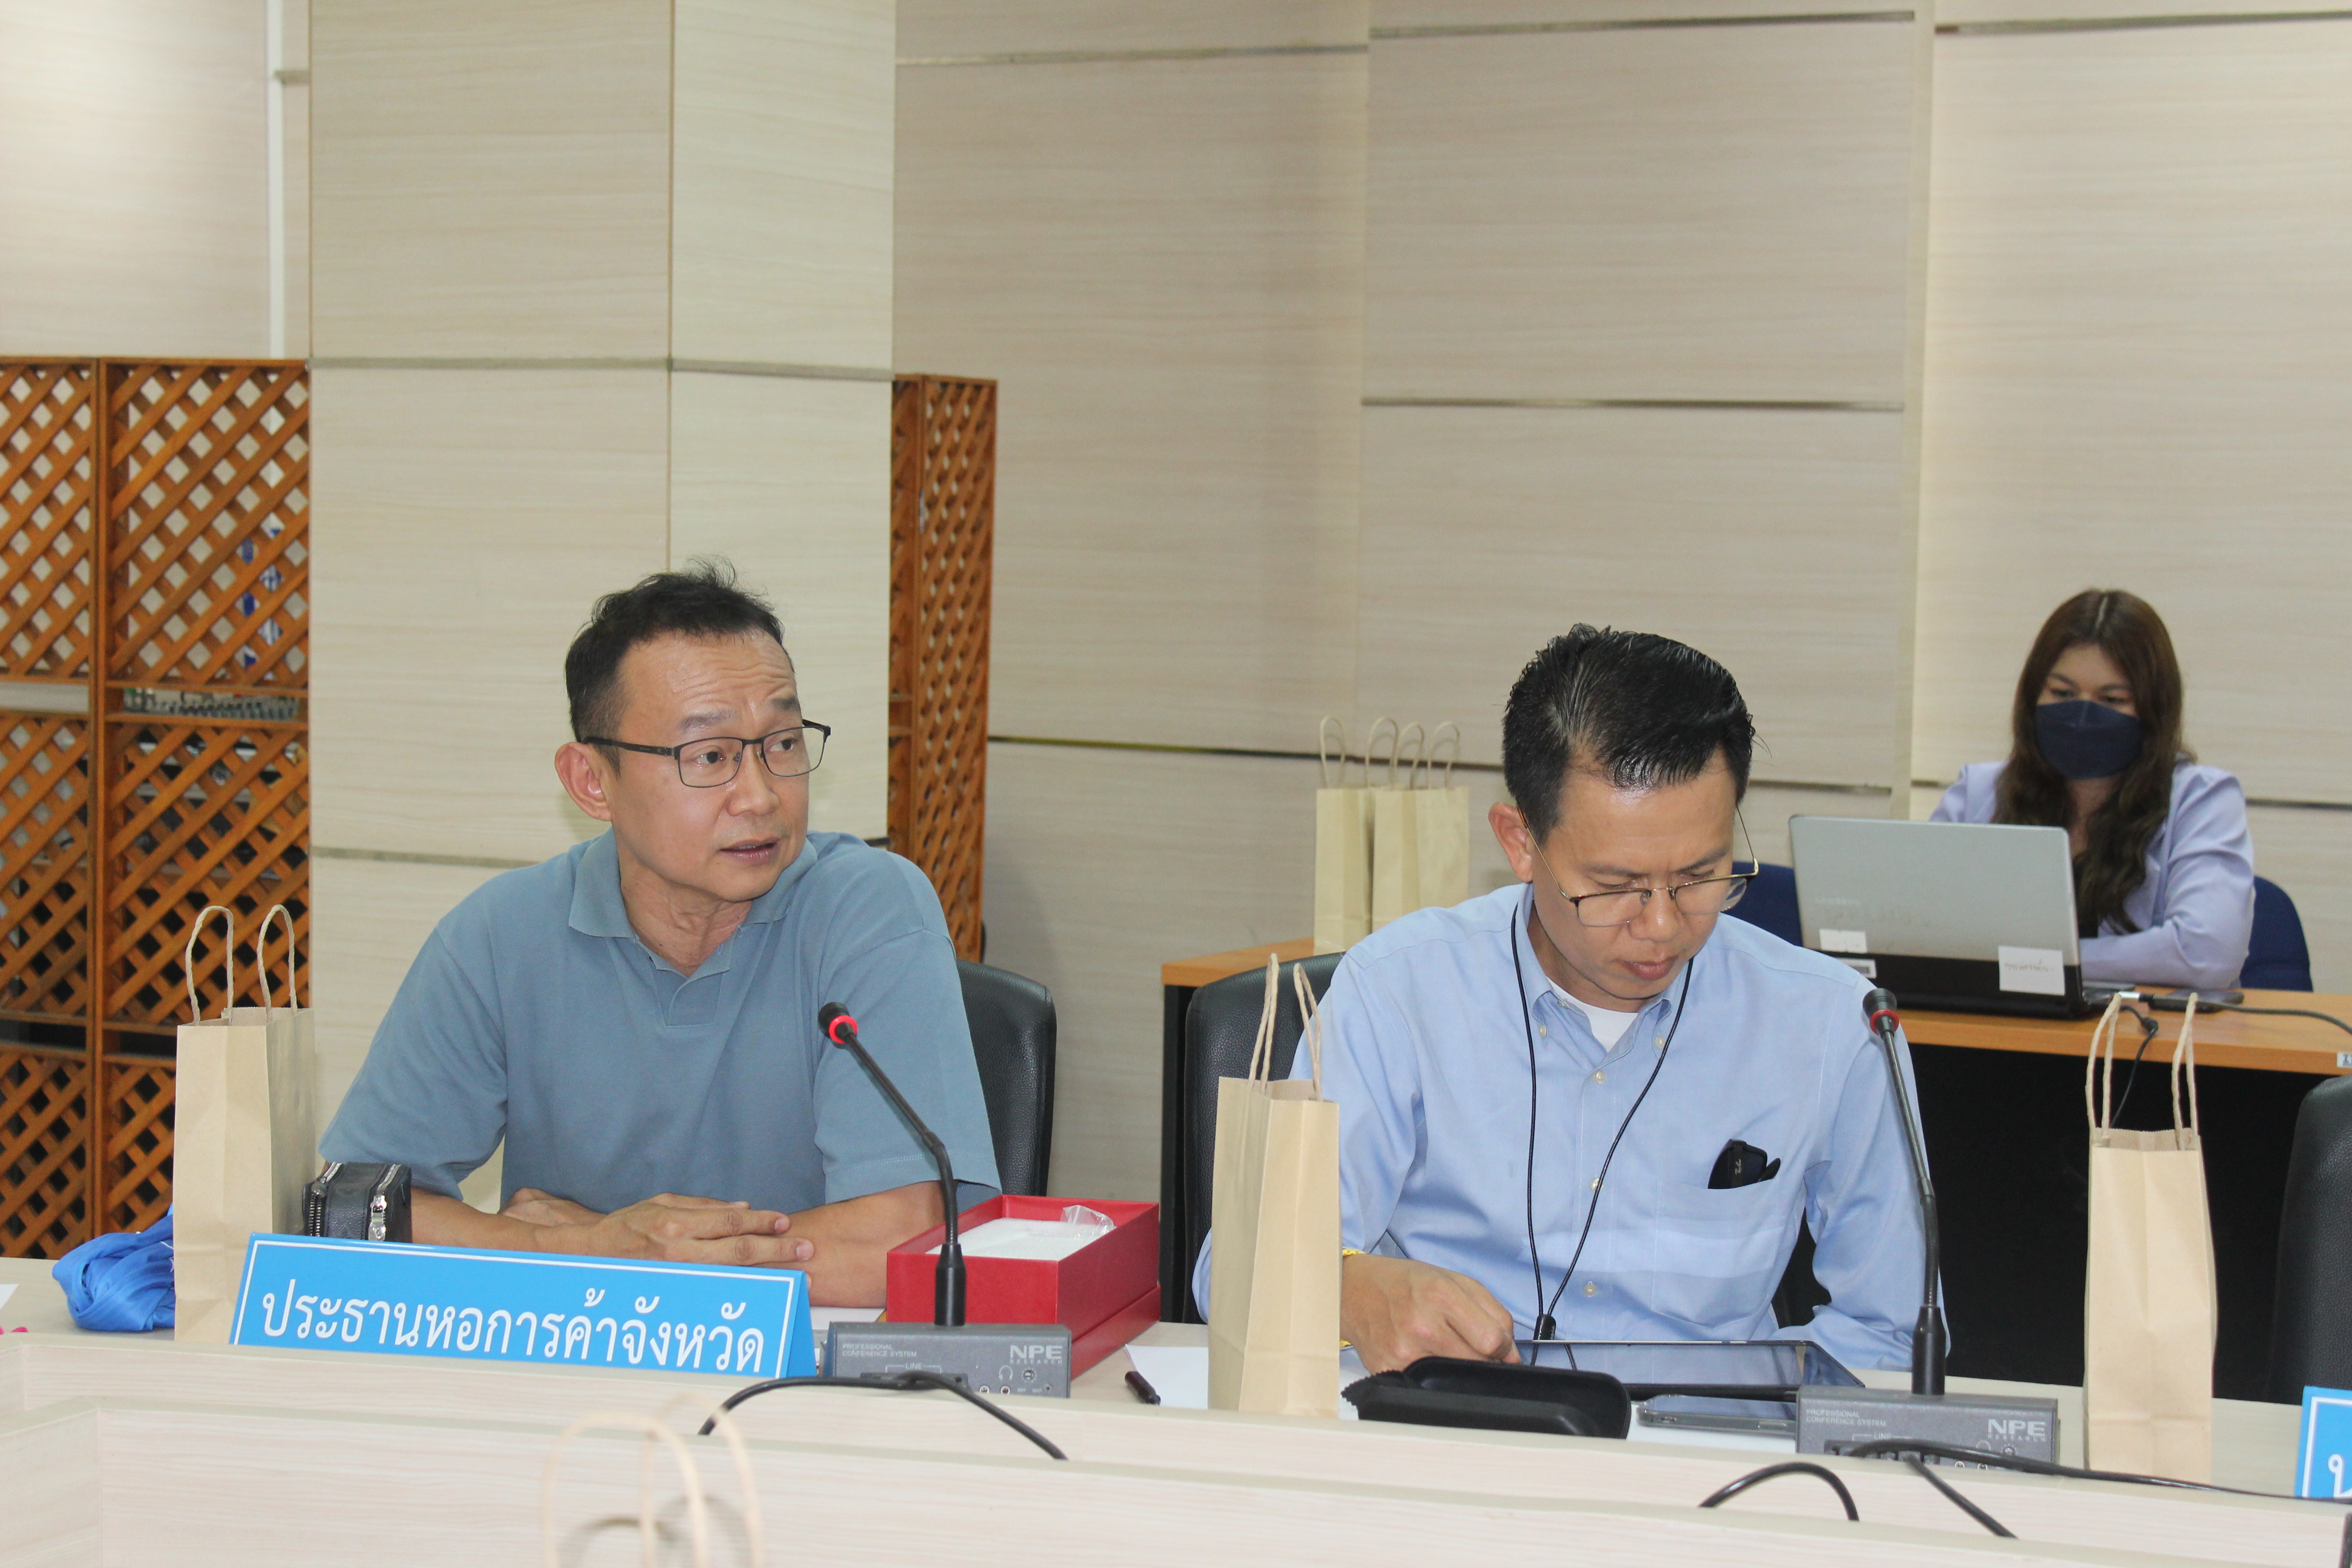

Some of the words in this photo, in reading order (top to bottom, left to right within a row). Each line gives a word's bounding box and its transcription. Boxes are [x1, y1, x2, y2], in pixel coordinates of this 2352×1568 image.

[262, 1279, 765, 1372] ประธานหอการค้าจังหวัด
[1010, 1345, 1062, 1359] NPE
[1806, 1409, 1860, 1417] PROFESSIONAL
[1806, 1416, 1855, 1425] CONFERENCE
[1987, 1418, 2046, 1436] NPE
[1987, 1434, 2045, 1442] RESEARCH
